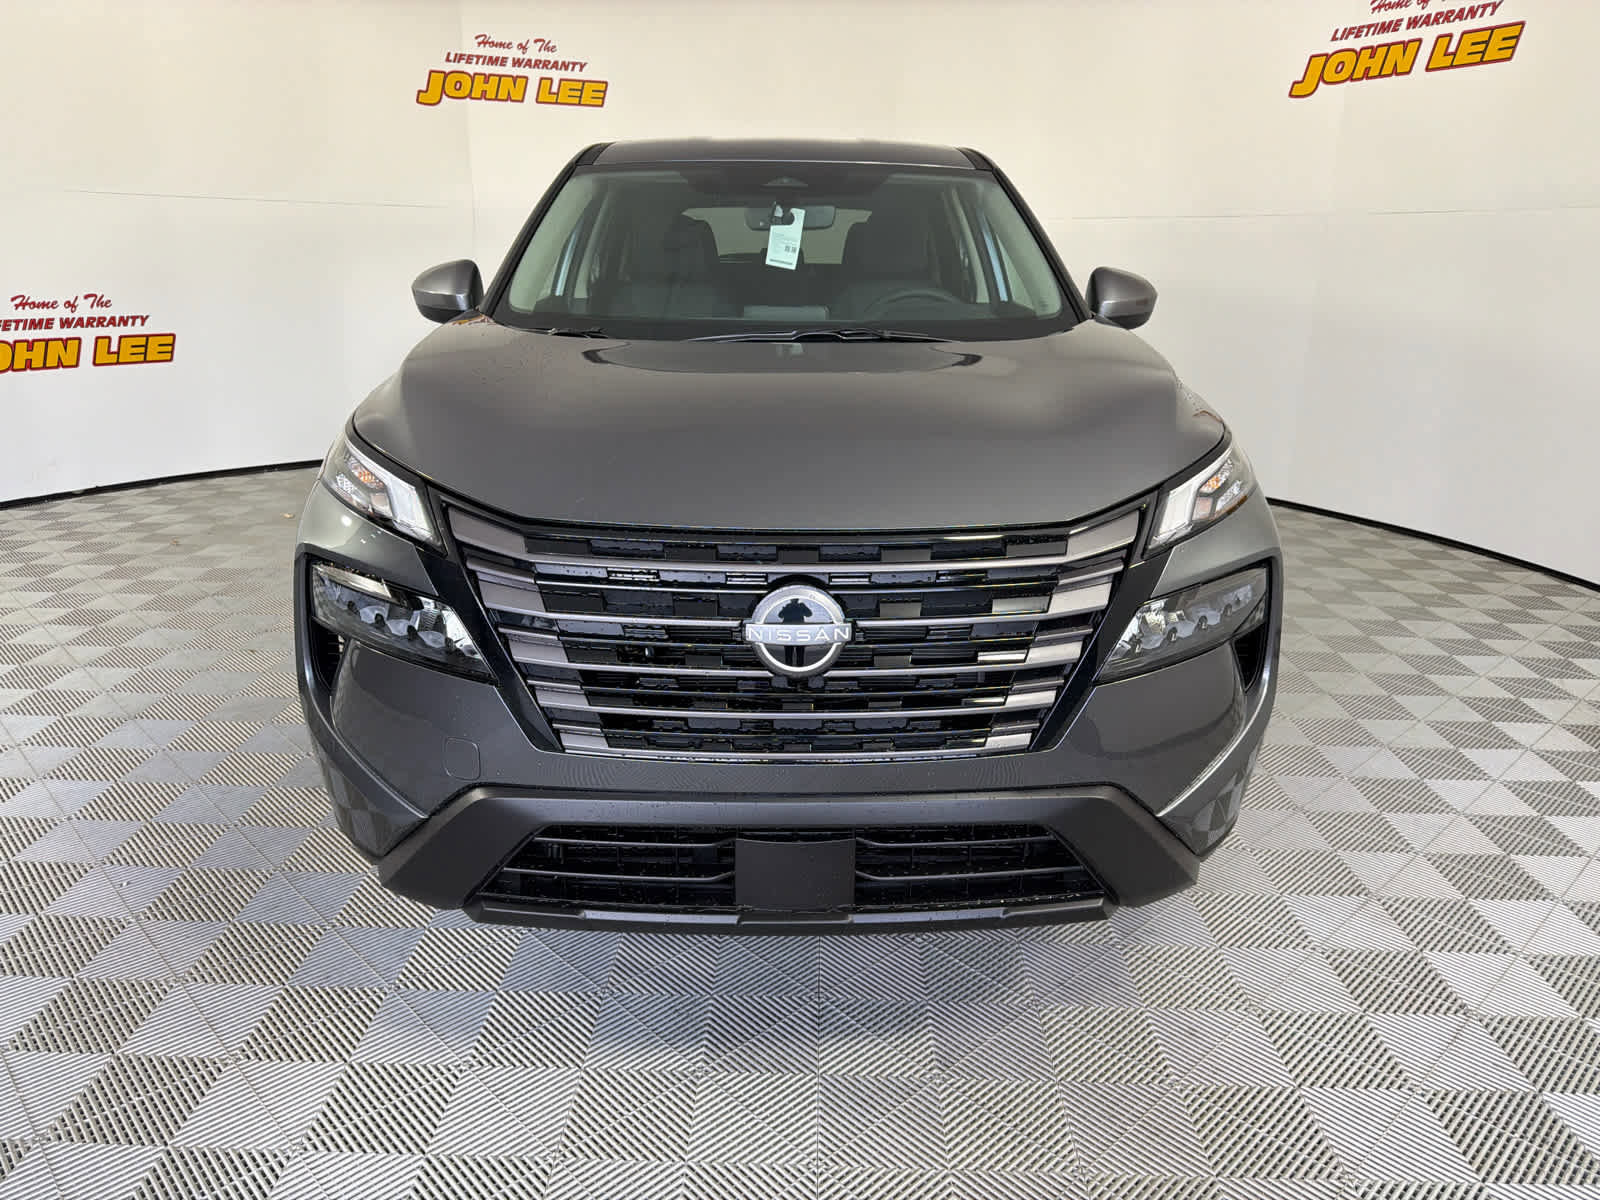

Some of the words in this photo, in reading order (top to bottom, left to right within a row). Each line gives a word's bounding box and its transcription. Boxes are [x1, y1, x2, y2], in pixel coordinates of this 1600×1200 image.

[1330, 17, 1404, 42] LIFETIME
[1405, 1, 1502, 30] WARRANTY
[474, 33, 513, 50] Home
[517, 39, 530, 54] of
[534, 38, 557, 54] The
[445, 51, 508, 67] LIFETIME
[512, 57, 588, 73] WARRANTY
[1288, 38, 1423, 99] JOHN
[1424, 20, 1526, 73] LEE
[416, 69, 529, 106] JOHN
[536, 77, 609, 108] LEE
[10, 294, 60, 311] Home
[63, 295, 79, 313] of
[83, 293, 112, 309] The
[59, 314, 150, 329] WARRANTY
[92, 332, 176, 367] LEE
[748, 627, 849, 641] NISSAN
